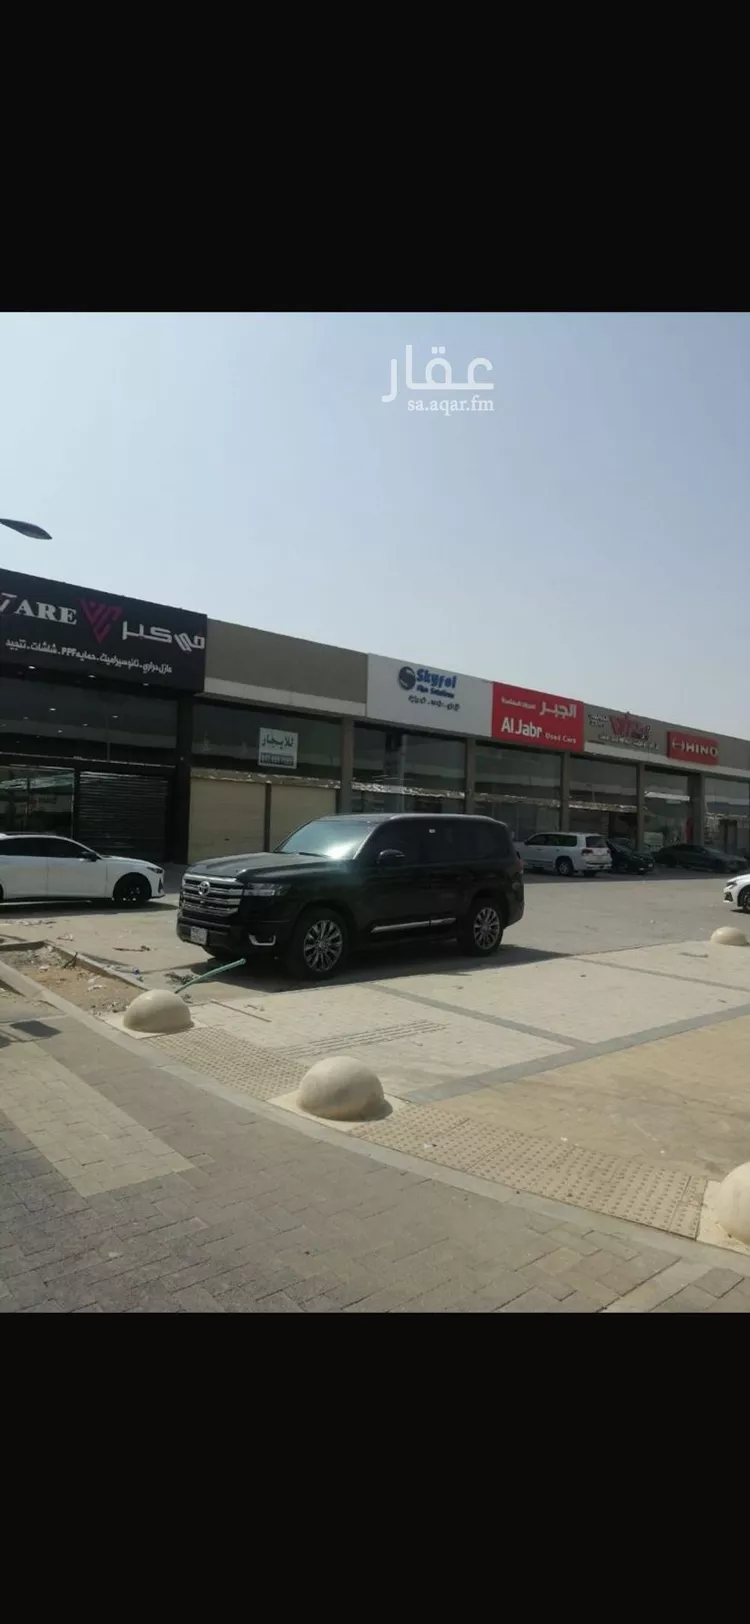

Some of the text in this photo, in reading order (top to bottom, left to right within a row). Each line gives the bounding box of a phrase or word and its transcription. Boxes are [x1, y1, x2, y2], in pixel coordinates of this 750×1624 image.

[540, 701, 577, 718] الجبر
[501, 716, 577, 744] Al Jabr Used Cars
[685, 741, 718, 757] HINO
